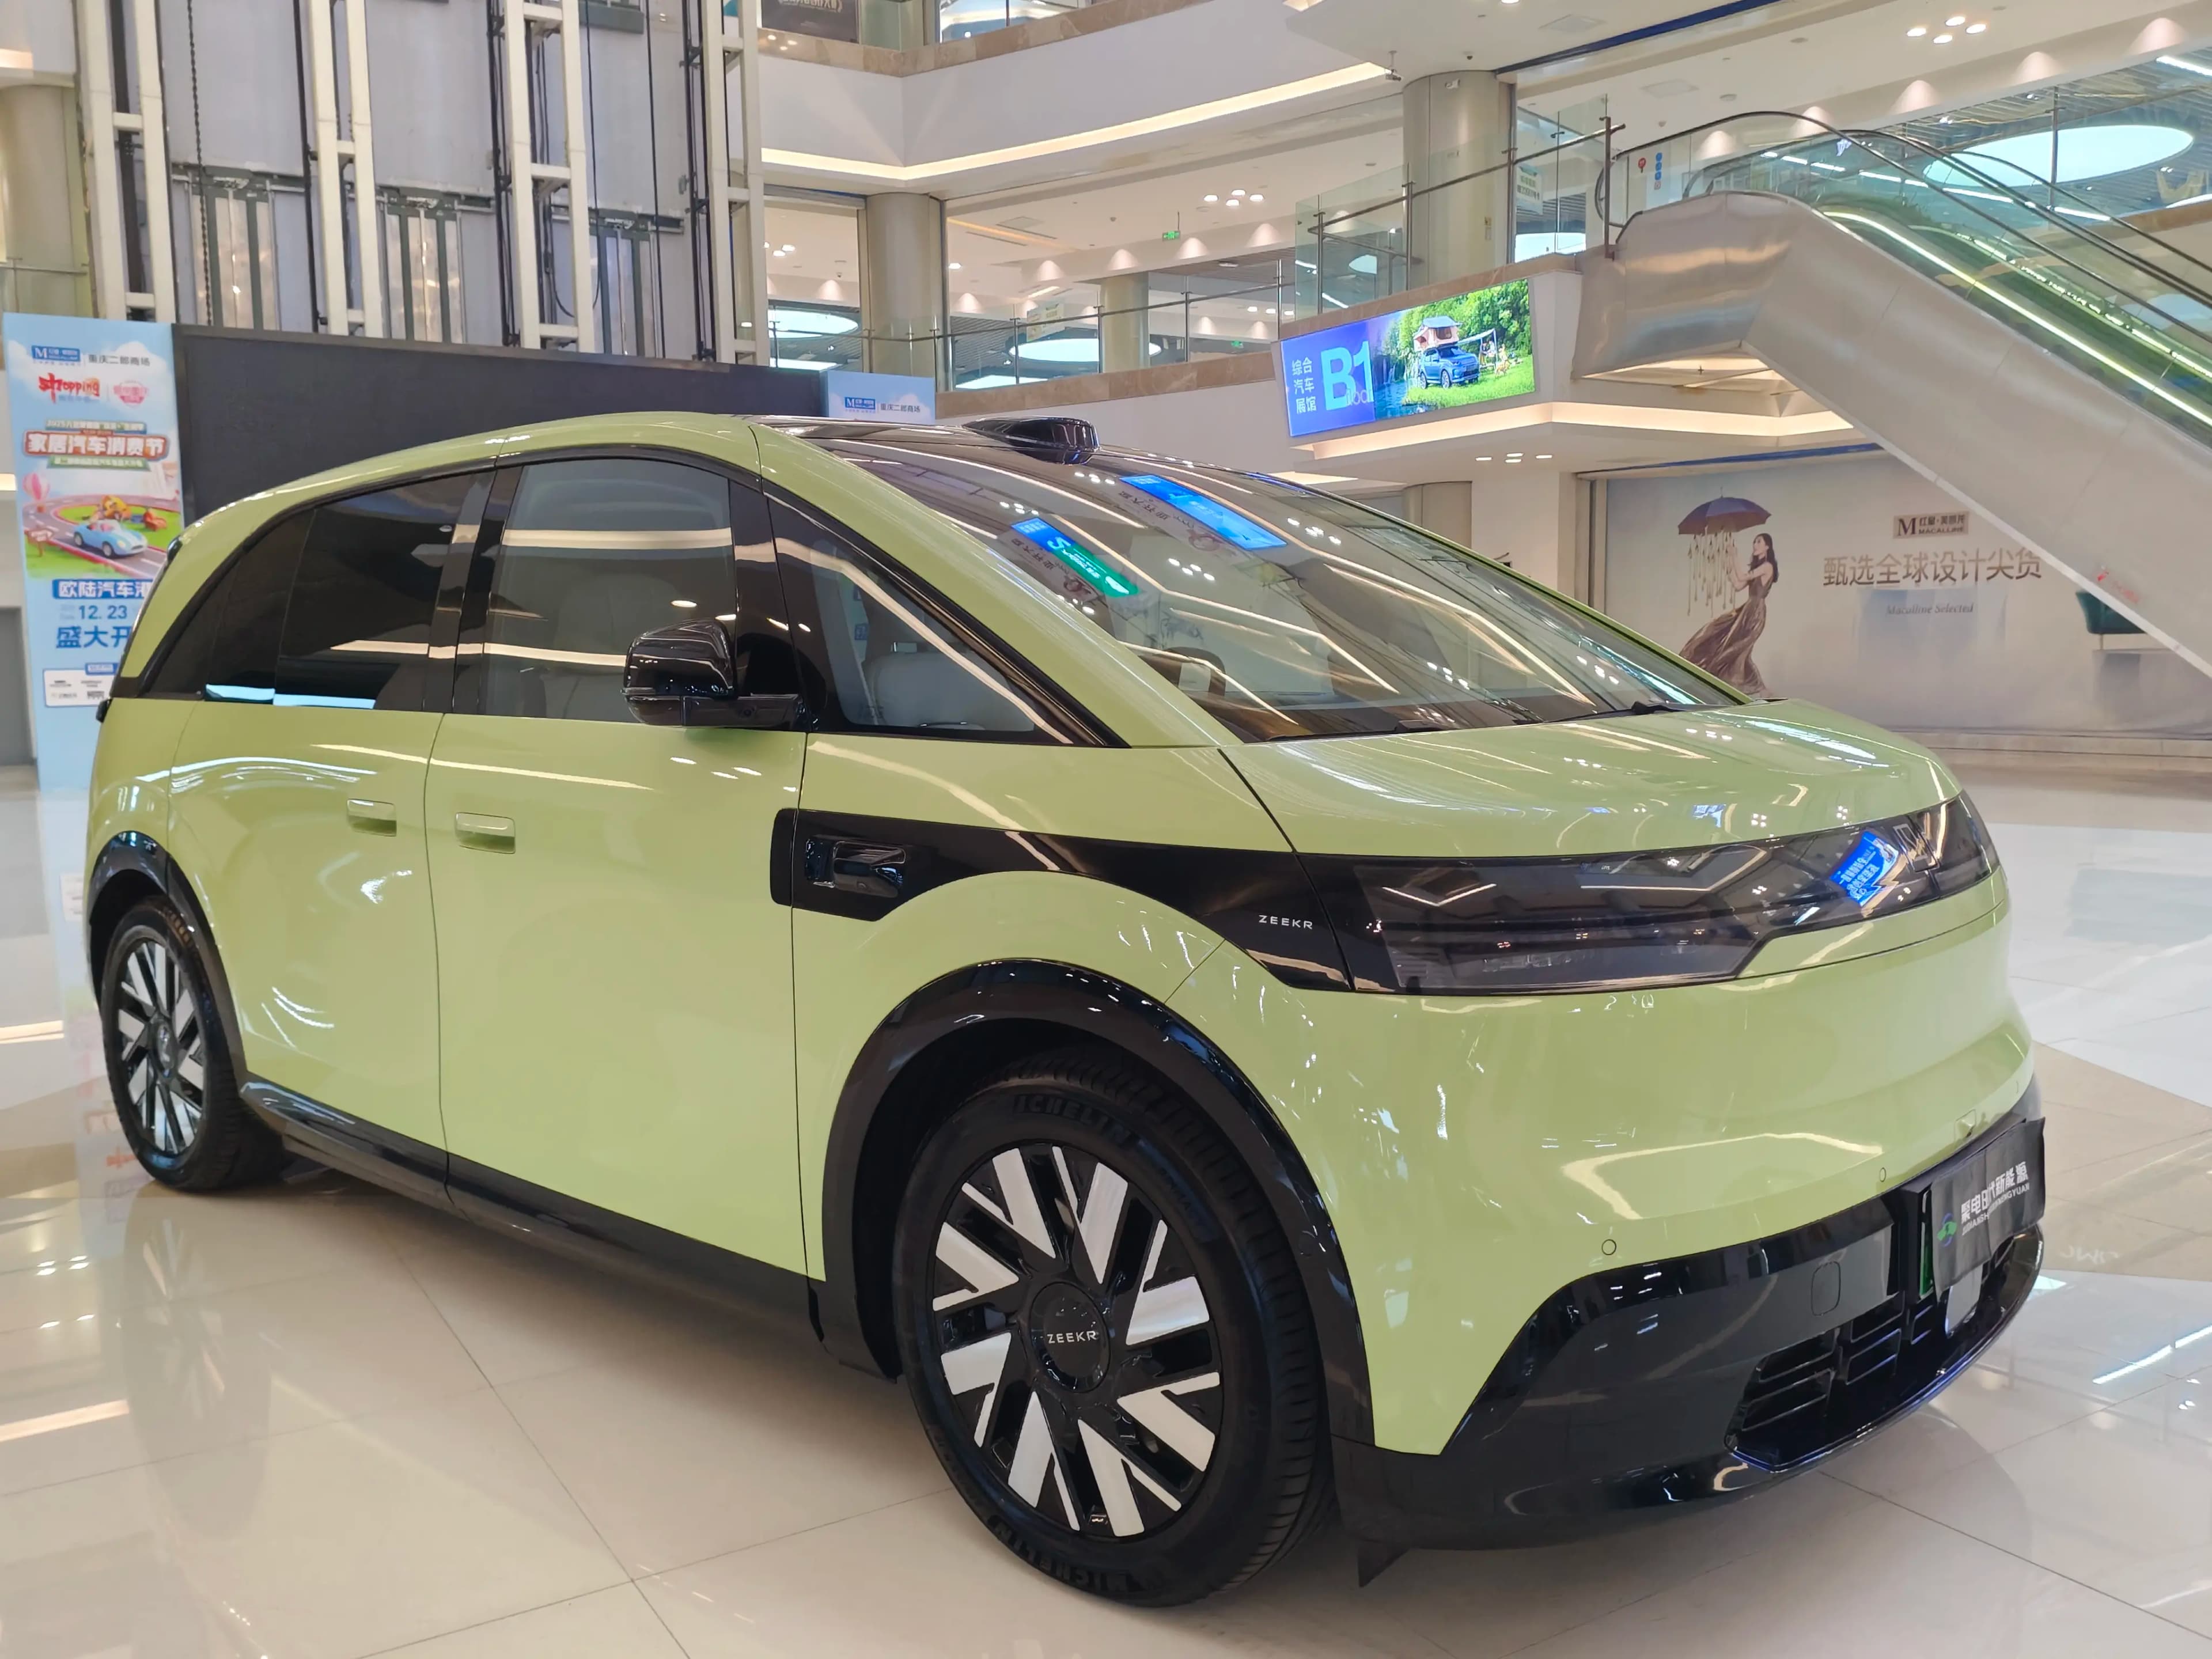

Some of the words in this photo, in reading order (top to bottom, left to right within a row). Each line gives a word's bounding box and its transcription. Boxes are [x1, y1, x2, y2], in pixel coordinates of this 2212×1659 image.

[89, 354, 150, 366] 重庆二郎商场
[1292, 357, 1312, 376] 综合
[1321, 340, 1374, 411] B1
[1293, 377, 1315, 395] 汽车
[880, 403, 921, 412] 重庆二郎商场
[1296, 396, 1317, 414] 展馆
[28, 433, 165, 457] 家居汽车消费节
[1823, 547, 2043, 586] 甄选全球设计尖货
[1887, 604, 1932, 615] Macalline
[1934, 602, 1974, 613] Selected
[1259, 915, 1312, 929] ZEEKR
[1047, 1330, 1097, 1344] ZEEKR
